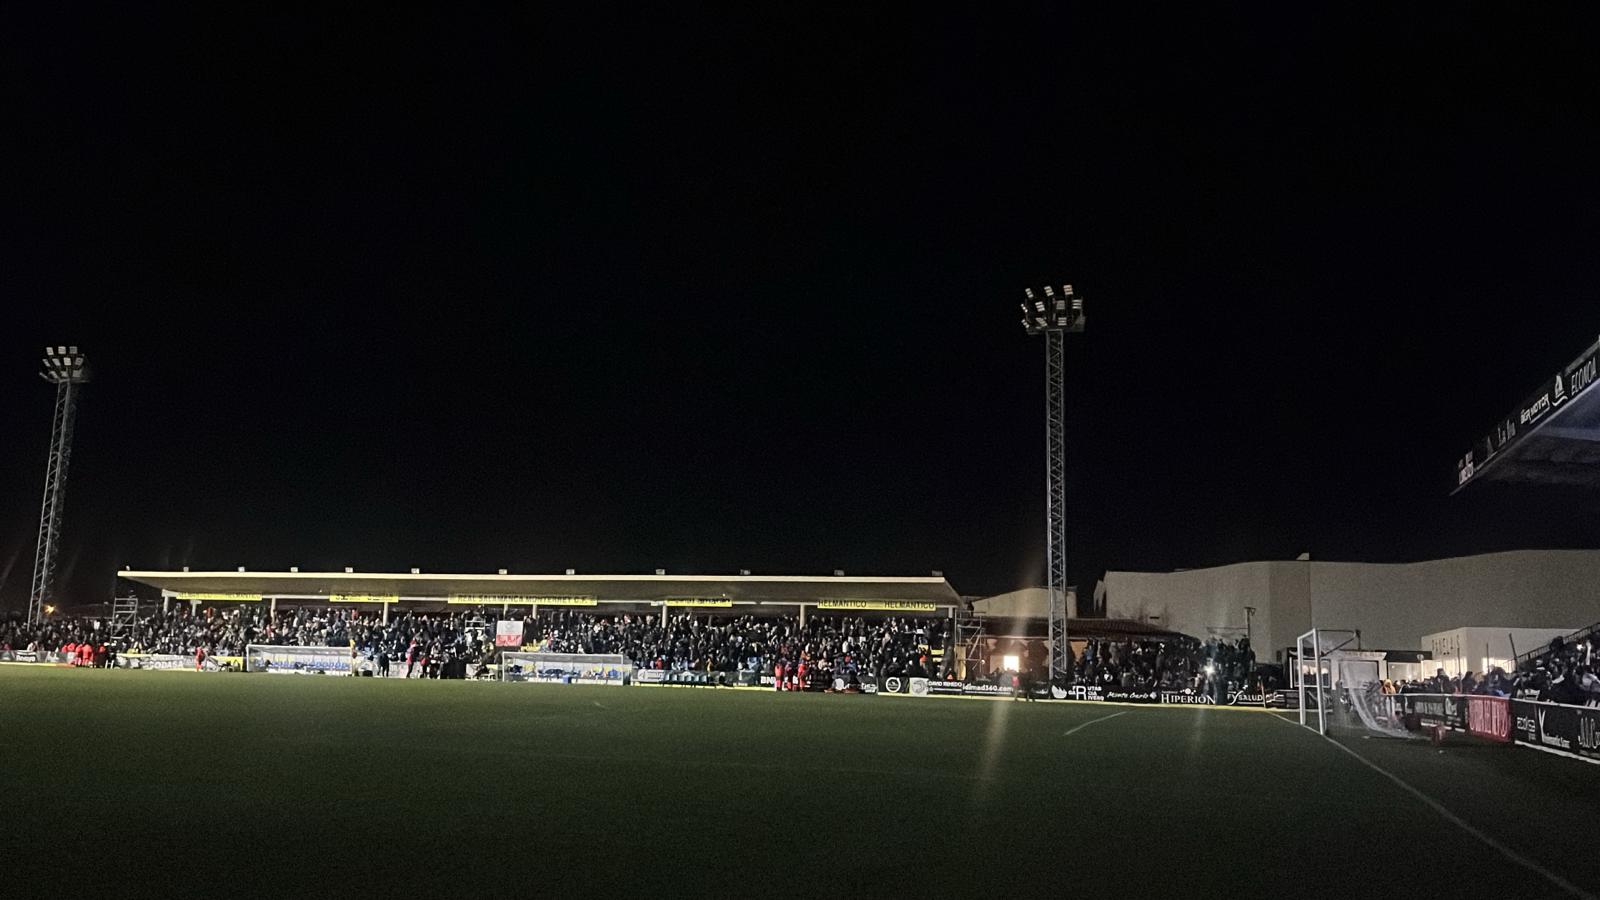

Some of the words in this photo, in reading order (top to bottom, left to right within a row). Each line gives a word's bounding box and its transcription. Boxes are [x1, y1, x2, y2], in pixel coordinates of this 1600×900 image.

[478, 594, 524, 603] SALAMANCA
[818, 600, 867, 608] HELMANTICO
[884, 601, 935, 610] HELMANTICO
